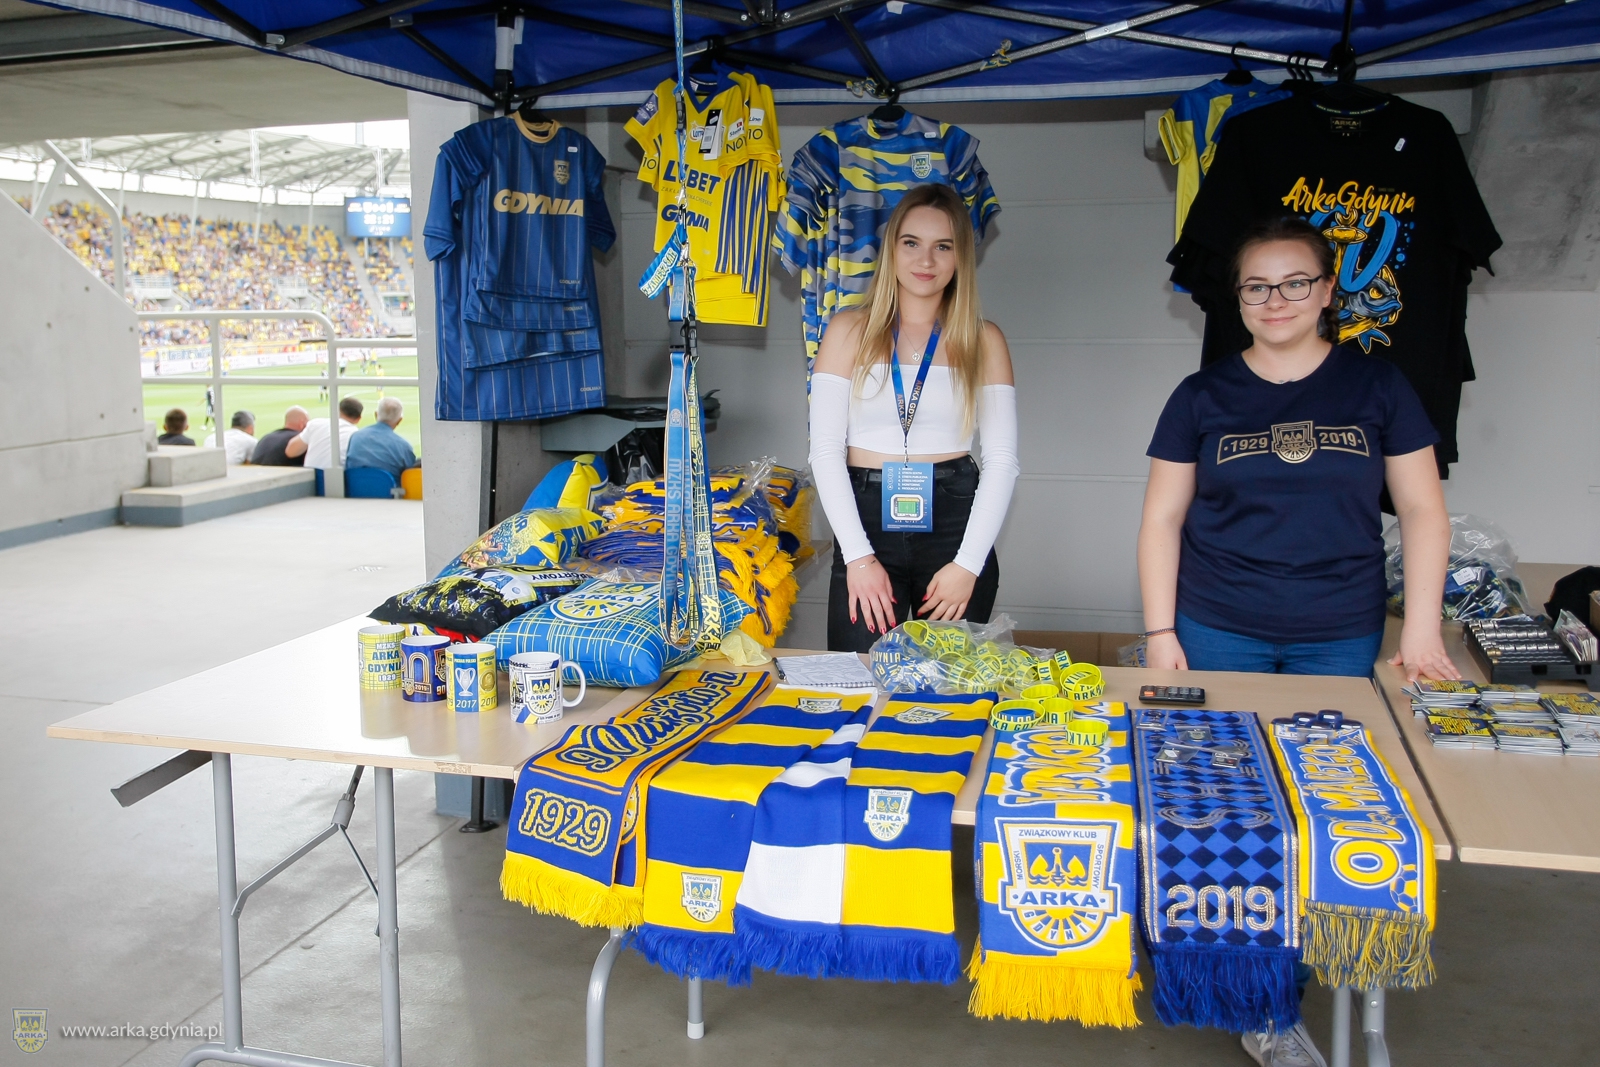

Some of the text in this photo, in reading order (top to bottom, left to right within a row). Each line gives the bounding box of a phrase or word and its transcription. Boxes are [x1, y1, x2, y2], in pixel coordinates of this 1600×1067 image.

[493, 188, 584, 217] GDYNIA
[1281, 176, 1416, 227] Arka Gdynia
[661, 203, 710, 232] GYNIA
[911, 379, 923, 401] ARKA
[1231, 437, 1268, 452] 1929
[1318, 432, 1357, 447] 2019
[575, 594, 633, 602] ARKA
[372, 650, 400, 660] ARKA
[456, 699, 477, 708] 2017
[529, 693, 553, 701] ARKA
[1066, 732, 1097, 746] TYLK
[521, 790, 610, 855] 1929
[871, 814, 902, 822] ARKA
[1018, 828, 1097, 839] ZWIĄZKOWY KLUB
[1328, 820, 1406, 889] OD
[1013, 850, 1023, 880] MORSKI
[1093, 844, 1105, 888] SPORTOWY
[688, 899, 715, 908] ARKA
[1019, 891, 1100, 908] ARKA
[1166, 884, 1276, 931] 2019
[1023, 910, 1099, 941] GDYNIA
